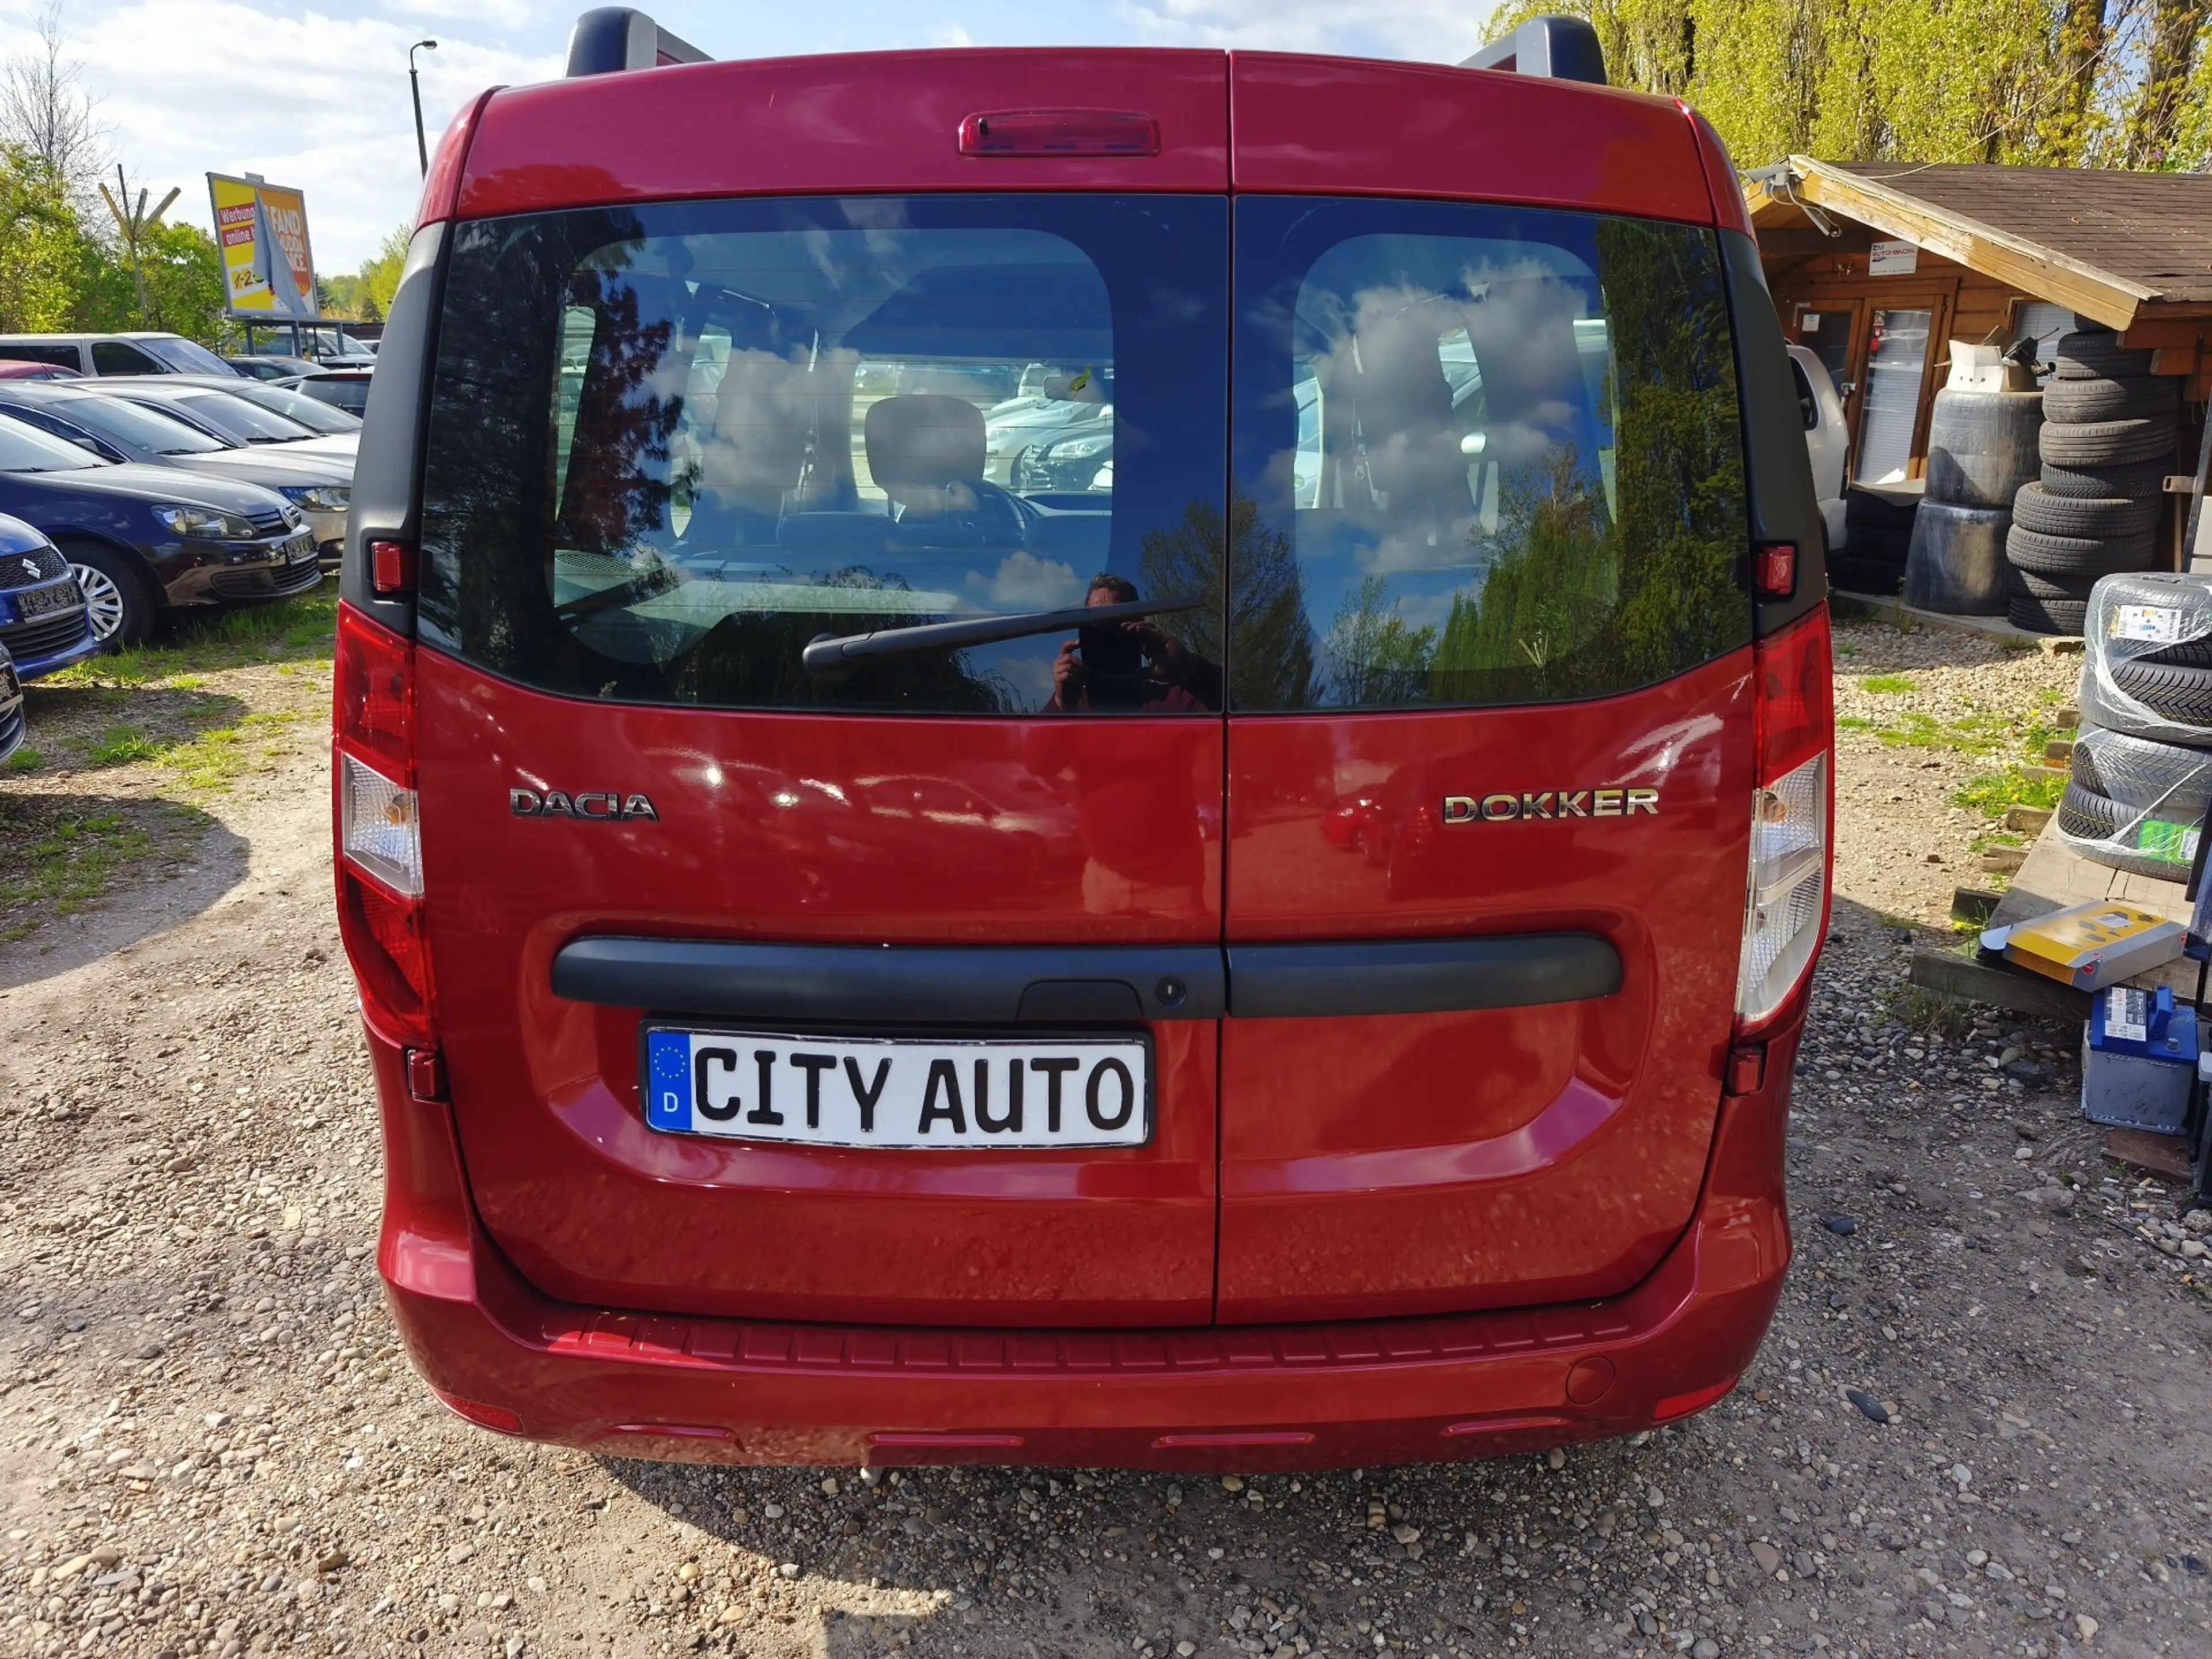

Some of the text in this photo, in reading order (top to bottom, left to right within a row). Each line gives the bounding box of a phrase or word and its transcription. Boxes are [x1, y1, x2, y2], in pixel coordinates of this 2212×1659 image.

[510, 788, 659, 821] DACIA
[1444, 789, 1659, 824] DOKKER
[663, 1092, 679, 1113] D
[694, 1048, 1135, 1134] CITY AUTO
